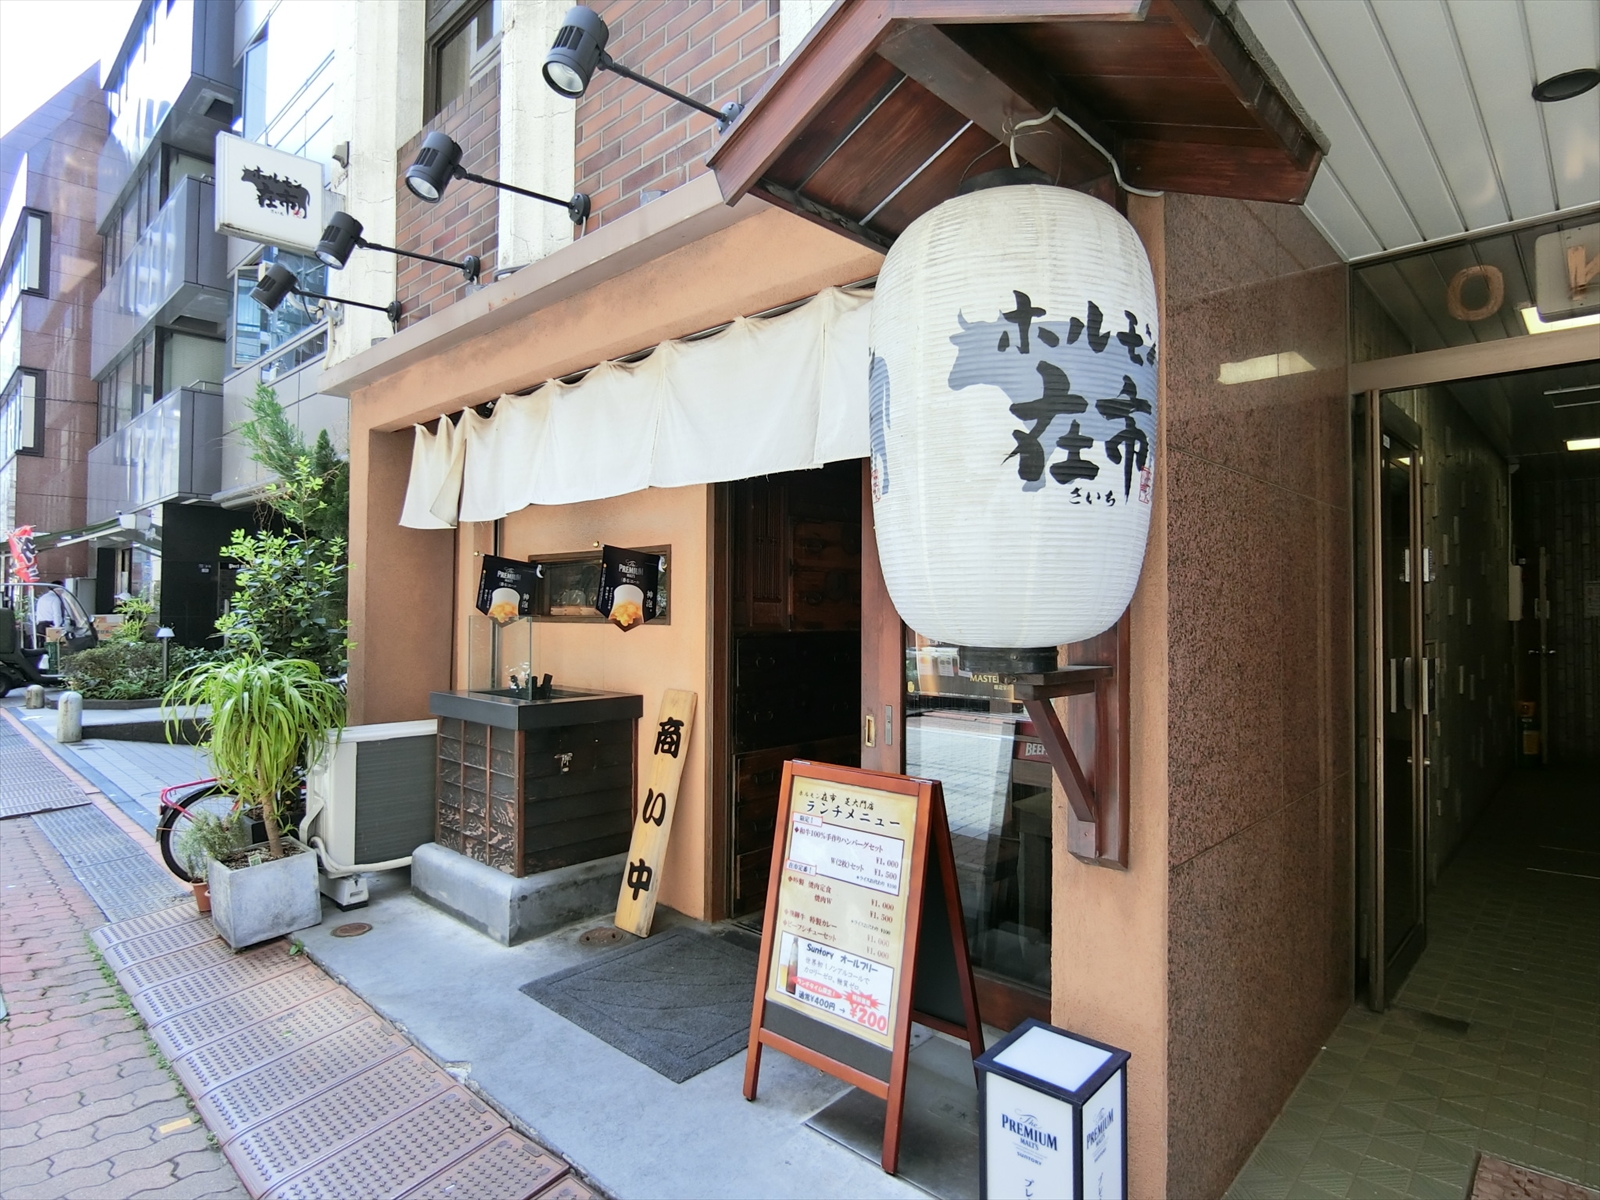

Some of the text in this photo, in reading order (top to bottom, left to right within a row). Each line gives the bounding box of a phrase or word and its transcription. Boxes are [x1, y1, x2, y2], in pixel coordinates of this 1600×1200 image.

[1001, 360, 1152, 506] 在市
[1069, 487, 1116, 507] さいち
[497, 569, 522, 581] PREMIUM
[618, 563, 644, 576] PREMIUM
[627, 717, 684, 900] 商い中
[807, 801, 901, 827] ランチメニュー
[806, 943, 878, 973] Suntory オールフリー
[849, 1004, 888, 1032] ¥200
[1001, 1113, 1058, 1151] PREMIUM
[1086, 1108, 1114, 1150] PREMIUM
[1016, 1151, 1042, 1166] SUNTORY
[1025, 1178, 1035, 1200] プレ
